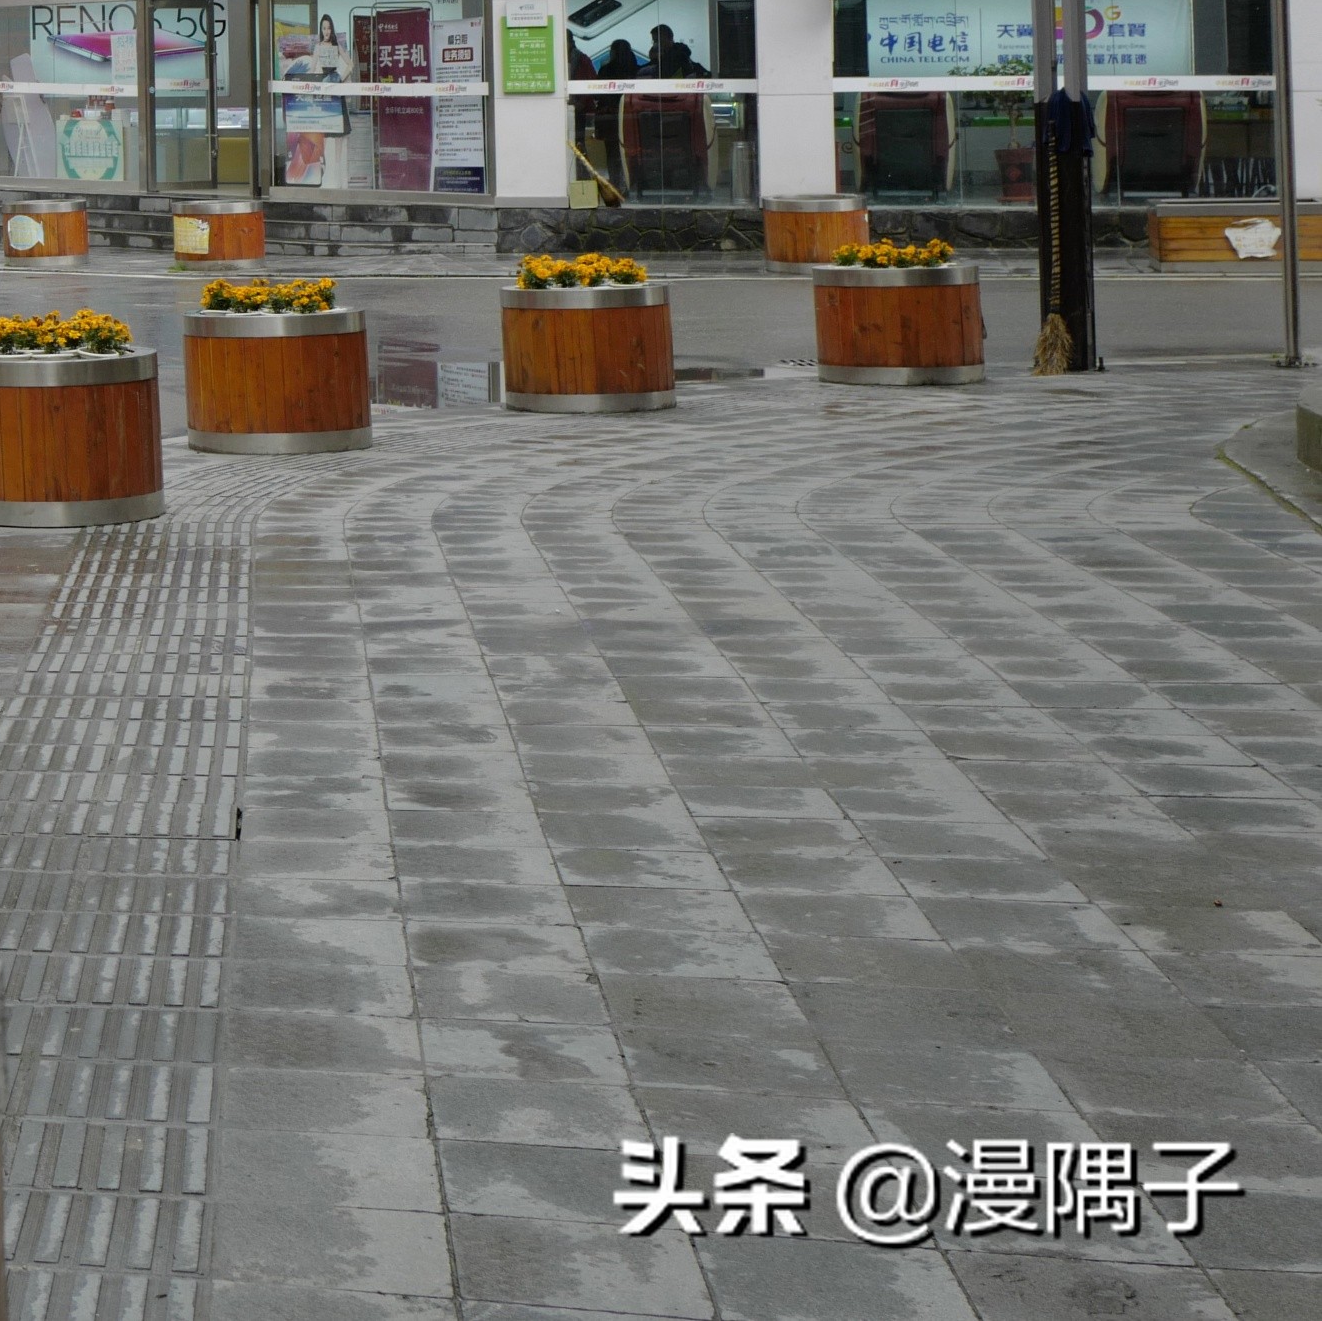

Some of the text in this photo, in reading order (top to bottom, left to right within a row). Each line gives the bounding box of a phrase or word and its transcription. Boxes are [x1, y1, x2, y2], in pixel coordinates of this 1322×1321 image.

[1107, 23, 1147, 38] 套餐
[879, 31, 969, 55] 中国电信
[379, 43, 427, 68] 买手机
[880, 56, 915, 64] CHINA
